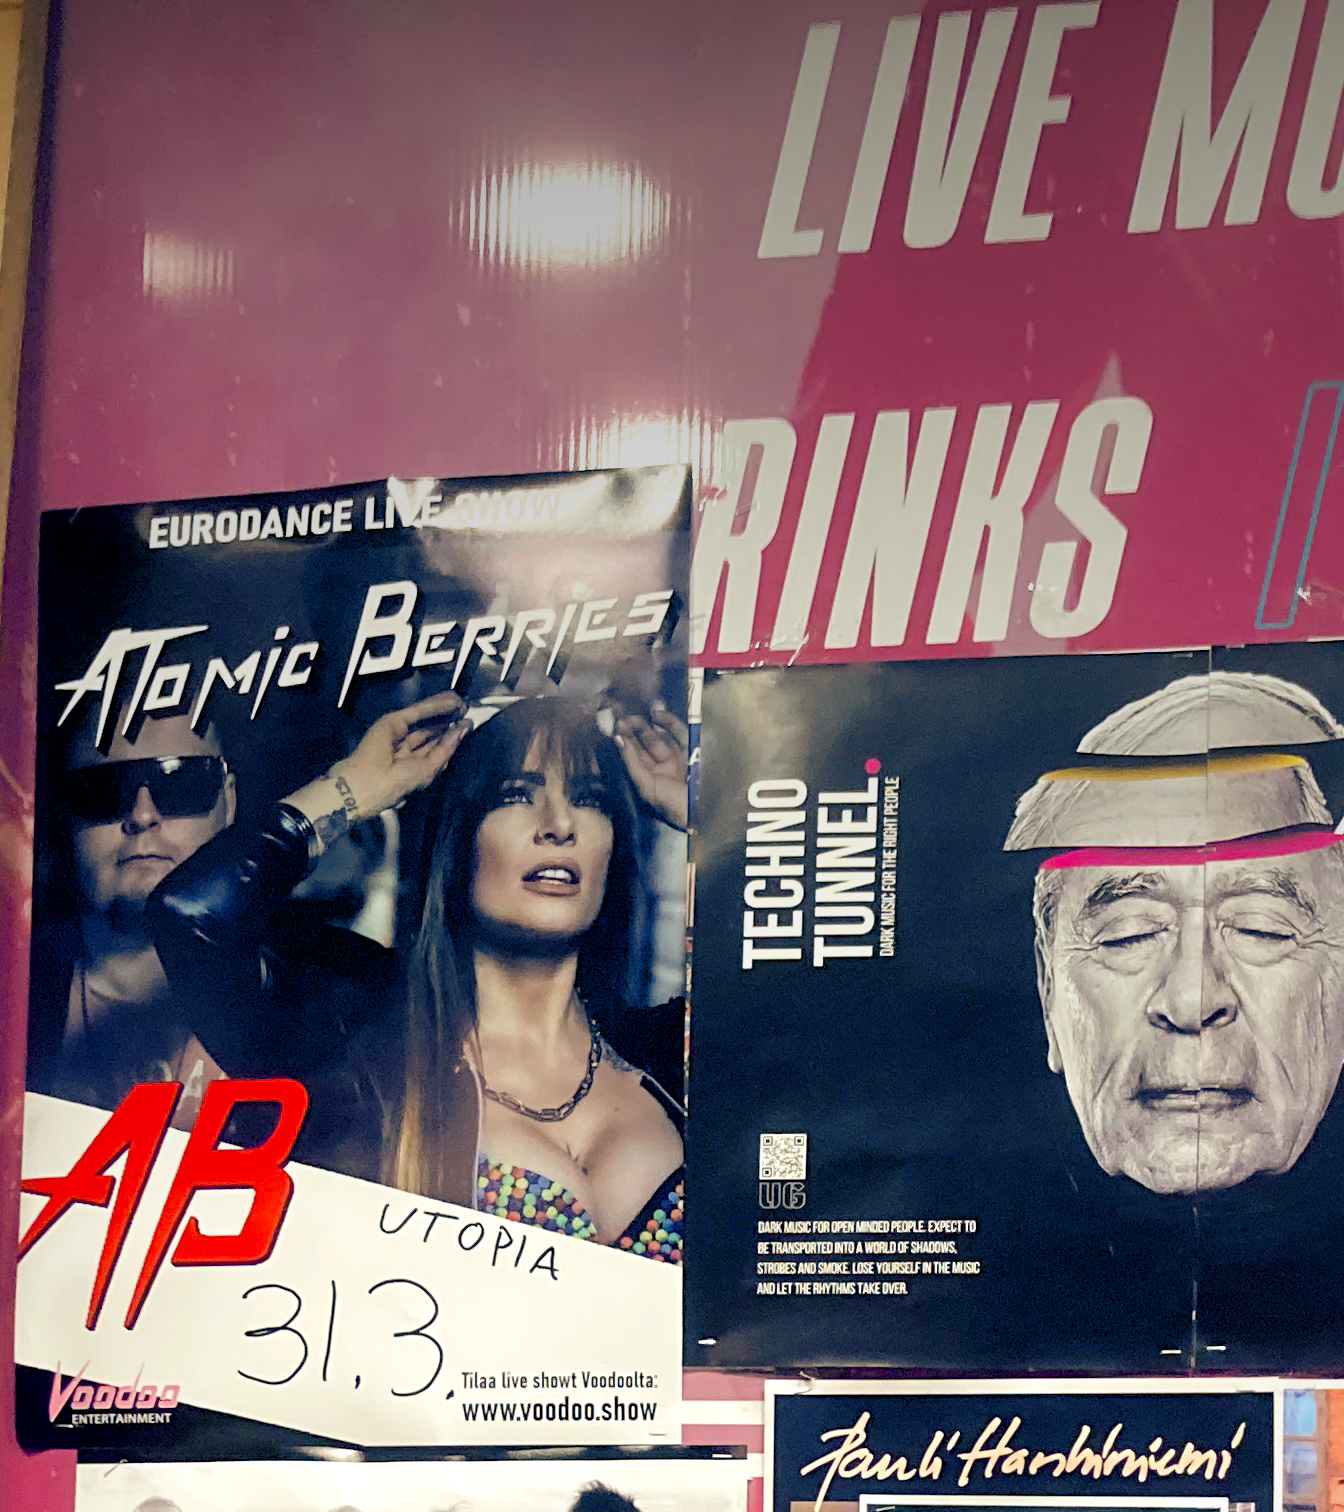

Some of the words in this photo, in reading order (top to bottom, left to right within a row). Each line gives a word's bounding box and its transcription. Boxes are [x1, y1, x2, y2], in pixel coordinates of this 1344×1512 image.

[758, 2, 1099, 259] LIVE
[149, 499, 353, 549] EURODANCE
[365, 494, 443, 533] LIVE
[690, 396, 1154, 654] RINKS
[884, 775, 900, 815] PEOPLE
[742, 778, 808, 970] TECHNO
[19, 1078, 309, 1330] AB
[758, 1182, 806, 1209] UG
[379, 1203, 561, 1281] UTOPIA
[757, 1220, 783, 1234] DARK
[784, 1220, 811, 1234] MUSIC
[813, 1220, 830, 1233] FOR
[831, 1220, 855, 1233] OPEN
[856, 1220, 890, 1233] MINDED
[928, 1220, 962, 1233] EXPECT
[963, 1220, 977, 1233] TO
[757, 1241, 769, 1254] BE
[771, 1241, 833, 1254] TRANSPORTED
[834, 1241, 855, 1254] INTO
[864, 1241, 896, 1254] WORLD
[898, 1241, 910, 1254] OF
[757, 1262, 797, 1275] STROBES
[798, 1262, 816, 1275] AND
[852, 1262, 875, 1275] LOSE
[876, 1262, 922, 1275] YOURSELF
[933, 1262, 951, 1275] THE
[952, 1262, 980, 1275] MUSIC
[757, 1282, 775, 1295] AND
[776, 1282, 793, 1295] LET
[794, 1282, 812, 1295] THE
[813, 1282, 856, 1295] RHYTHMS
[857, 1282, 880, 1295] TAKE
[882, 1282, 908, 1295] OVER.
[237, 1278, 457, 1401] 31.3.
[48, 1360, 180, 1425] Voodoo
[461, 1372, 495, 1391] Tilaa
[500, 1372, 528, 1391] live
[532, 1372, 578, 1391] showt
[581, 1372, 660, 1392] Voodoolta:
[71, 1410, 173, 1427] ENTERTAINMENT
[462, 1398, 658, 1426] www.voodoo.show
